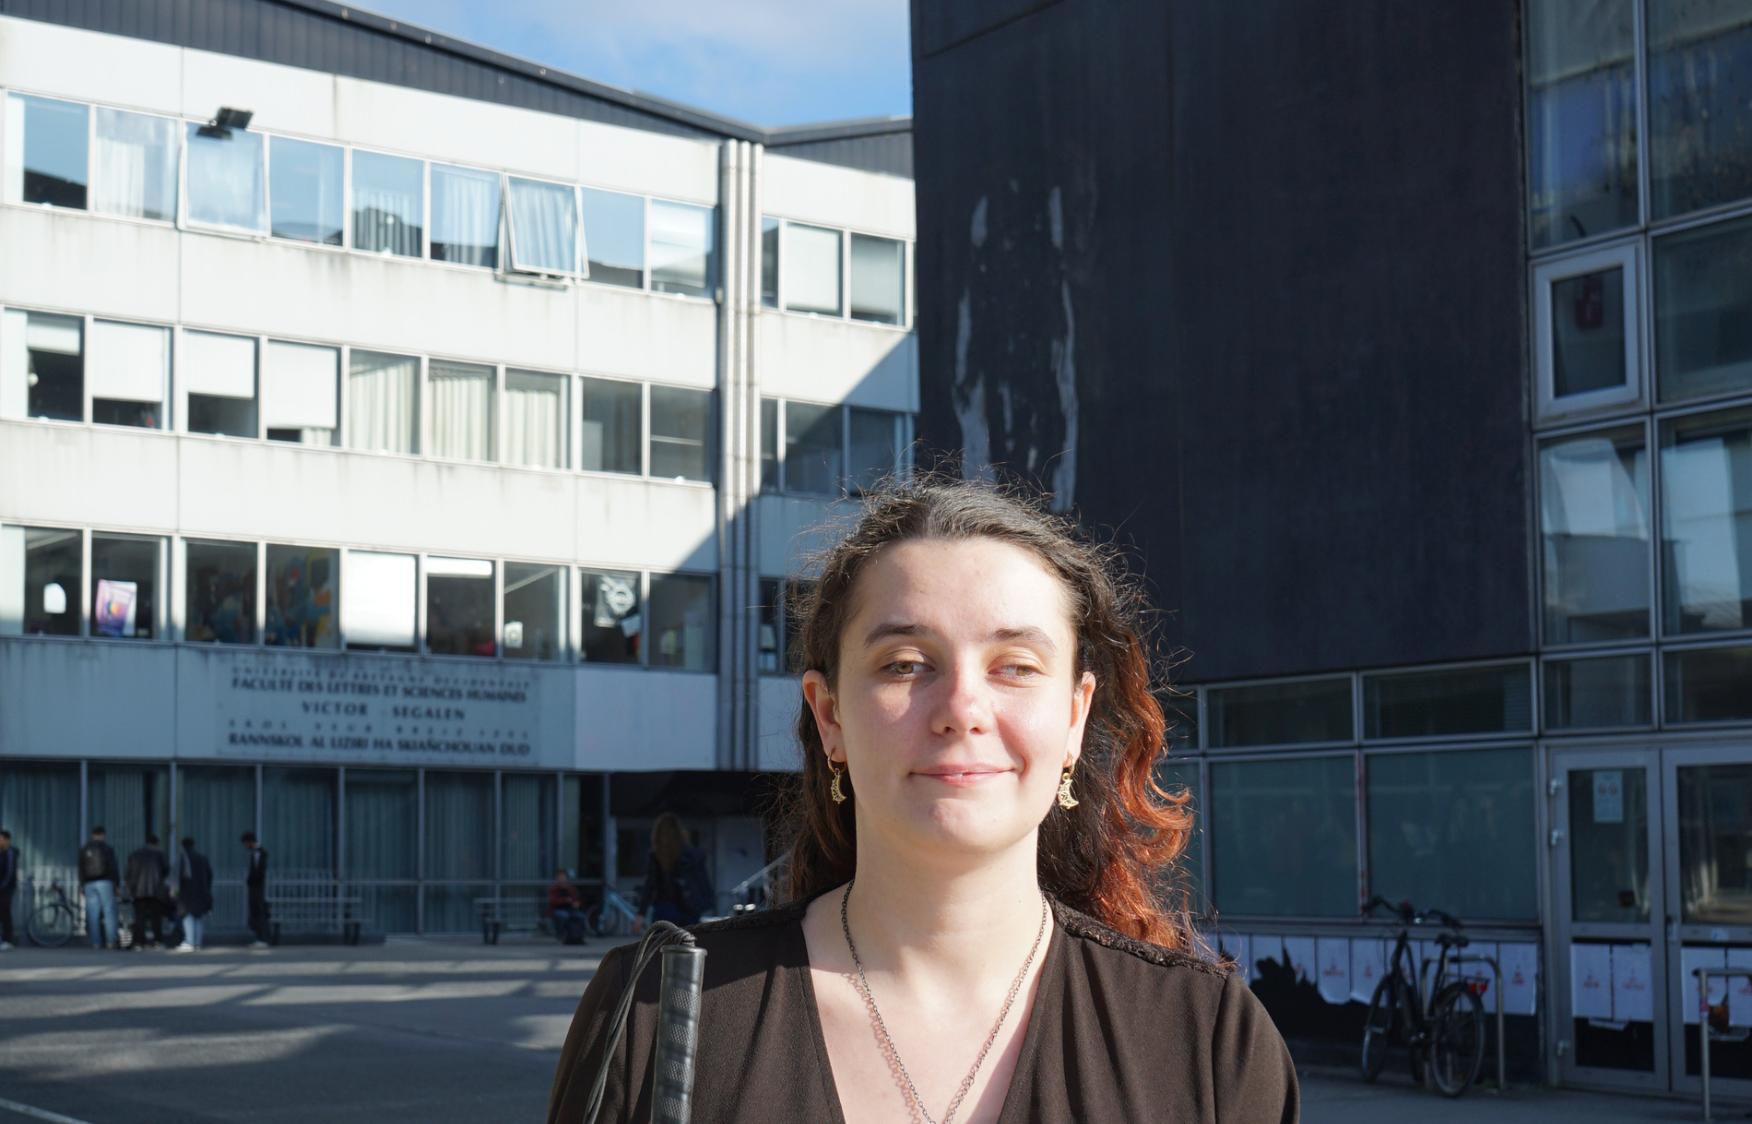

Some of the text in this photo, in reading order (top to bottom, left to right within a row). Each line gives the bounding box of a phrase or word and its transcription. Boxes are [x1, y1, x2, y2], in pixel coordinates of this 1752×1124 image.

[327, 682, 380, 696] LETTRES
[383, 686, 398, 697] ET
[403, 687, 463, 700] SCIENCES
[302, 701, 465, 720] VICTOR SEGALEN
